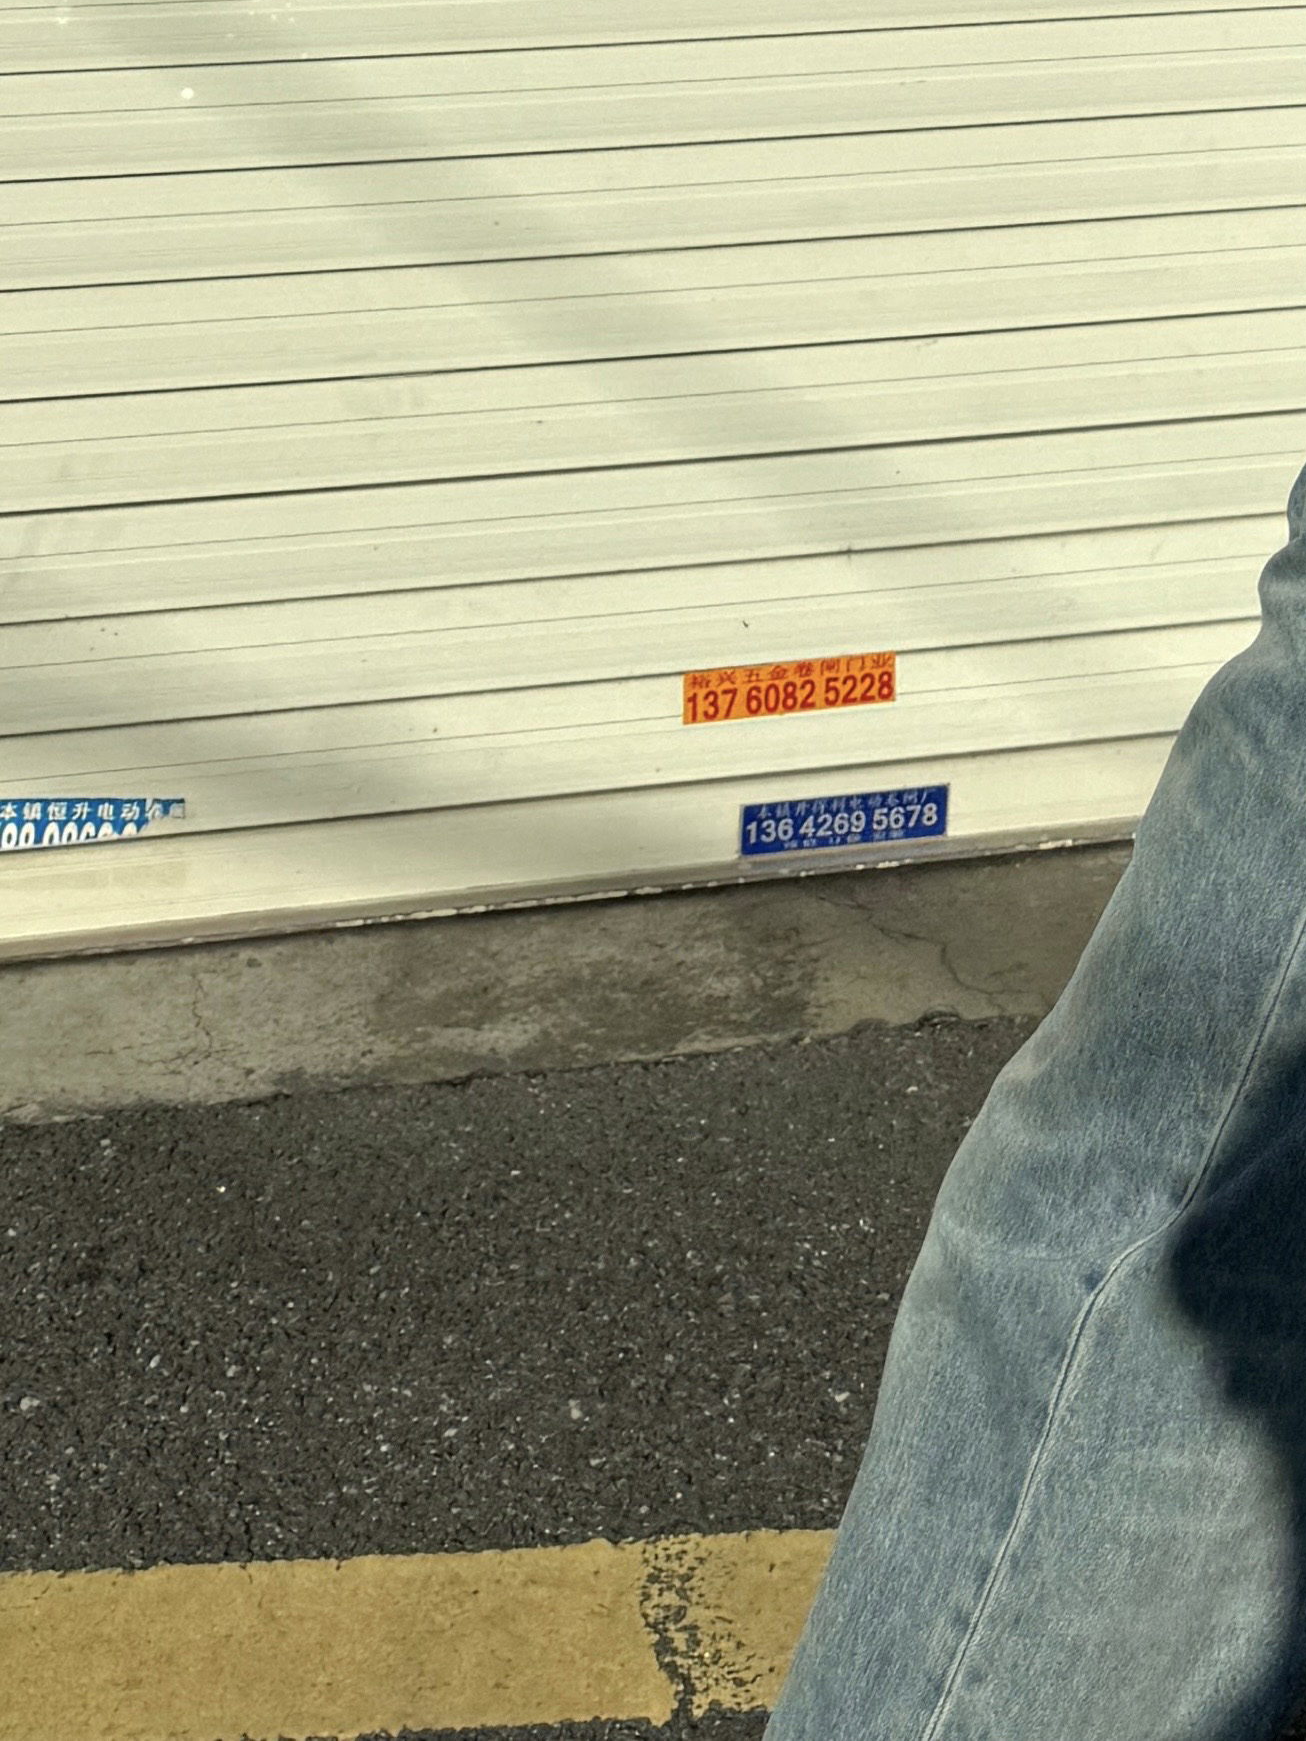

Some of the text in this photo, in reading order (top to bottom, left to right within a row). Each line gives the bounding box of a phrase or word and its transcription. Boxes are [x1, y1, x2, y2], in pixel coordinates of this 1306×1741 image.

[687, 671, 893, 722] 137 6082 5228
[0, 801, 185, 821] 本镇恒升电动
[746, 818, 794, 844] 136
[799, 810, 866, 837] 4269
[873, 803, 937, 830] 5678
